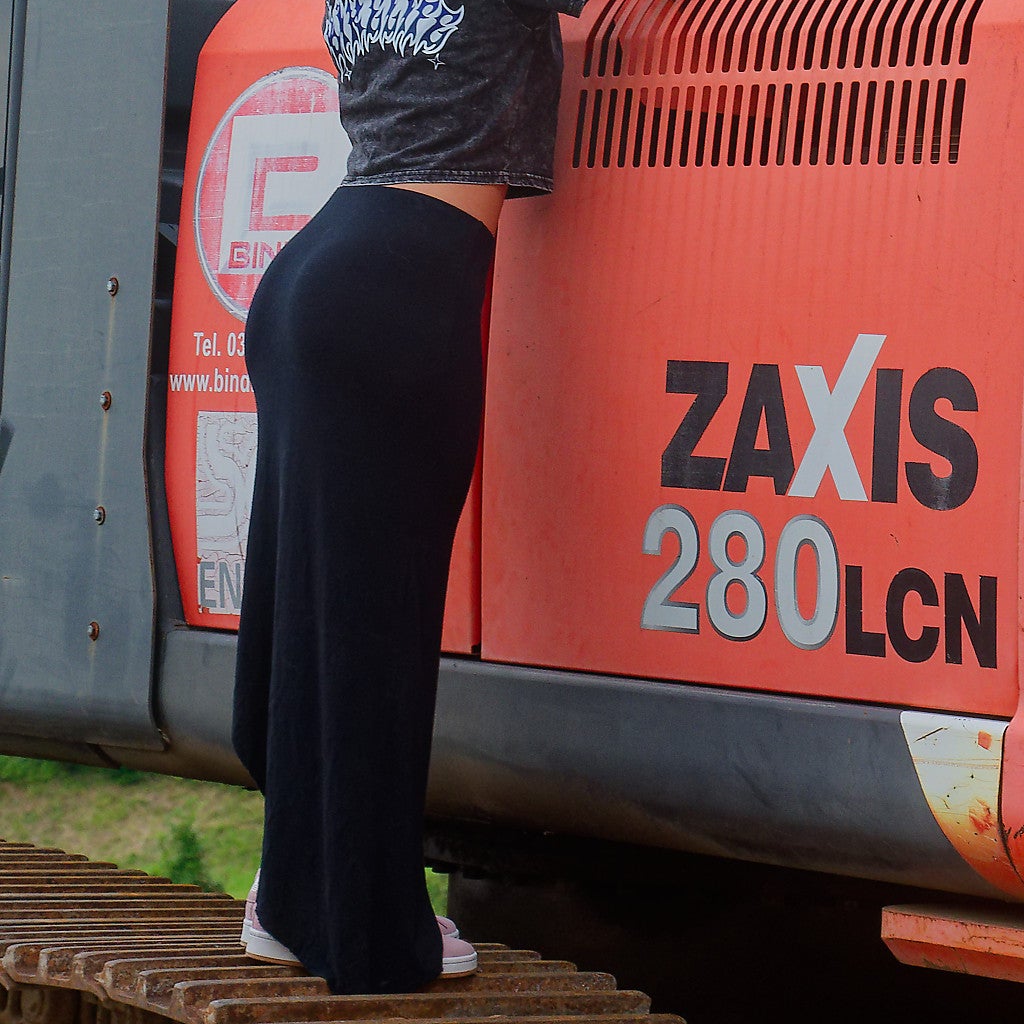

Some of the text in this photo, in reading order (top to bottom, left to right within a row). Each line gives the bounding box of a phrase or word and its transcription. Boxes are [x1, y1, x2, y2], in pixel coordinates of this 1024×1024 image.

[228, 241, 288, 269] BIN
[193, 332, 221, 357] Tel.
[169, 367, 255, 394] www.bind
[660, 333, 979, 511] ZAXIS
